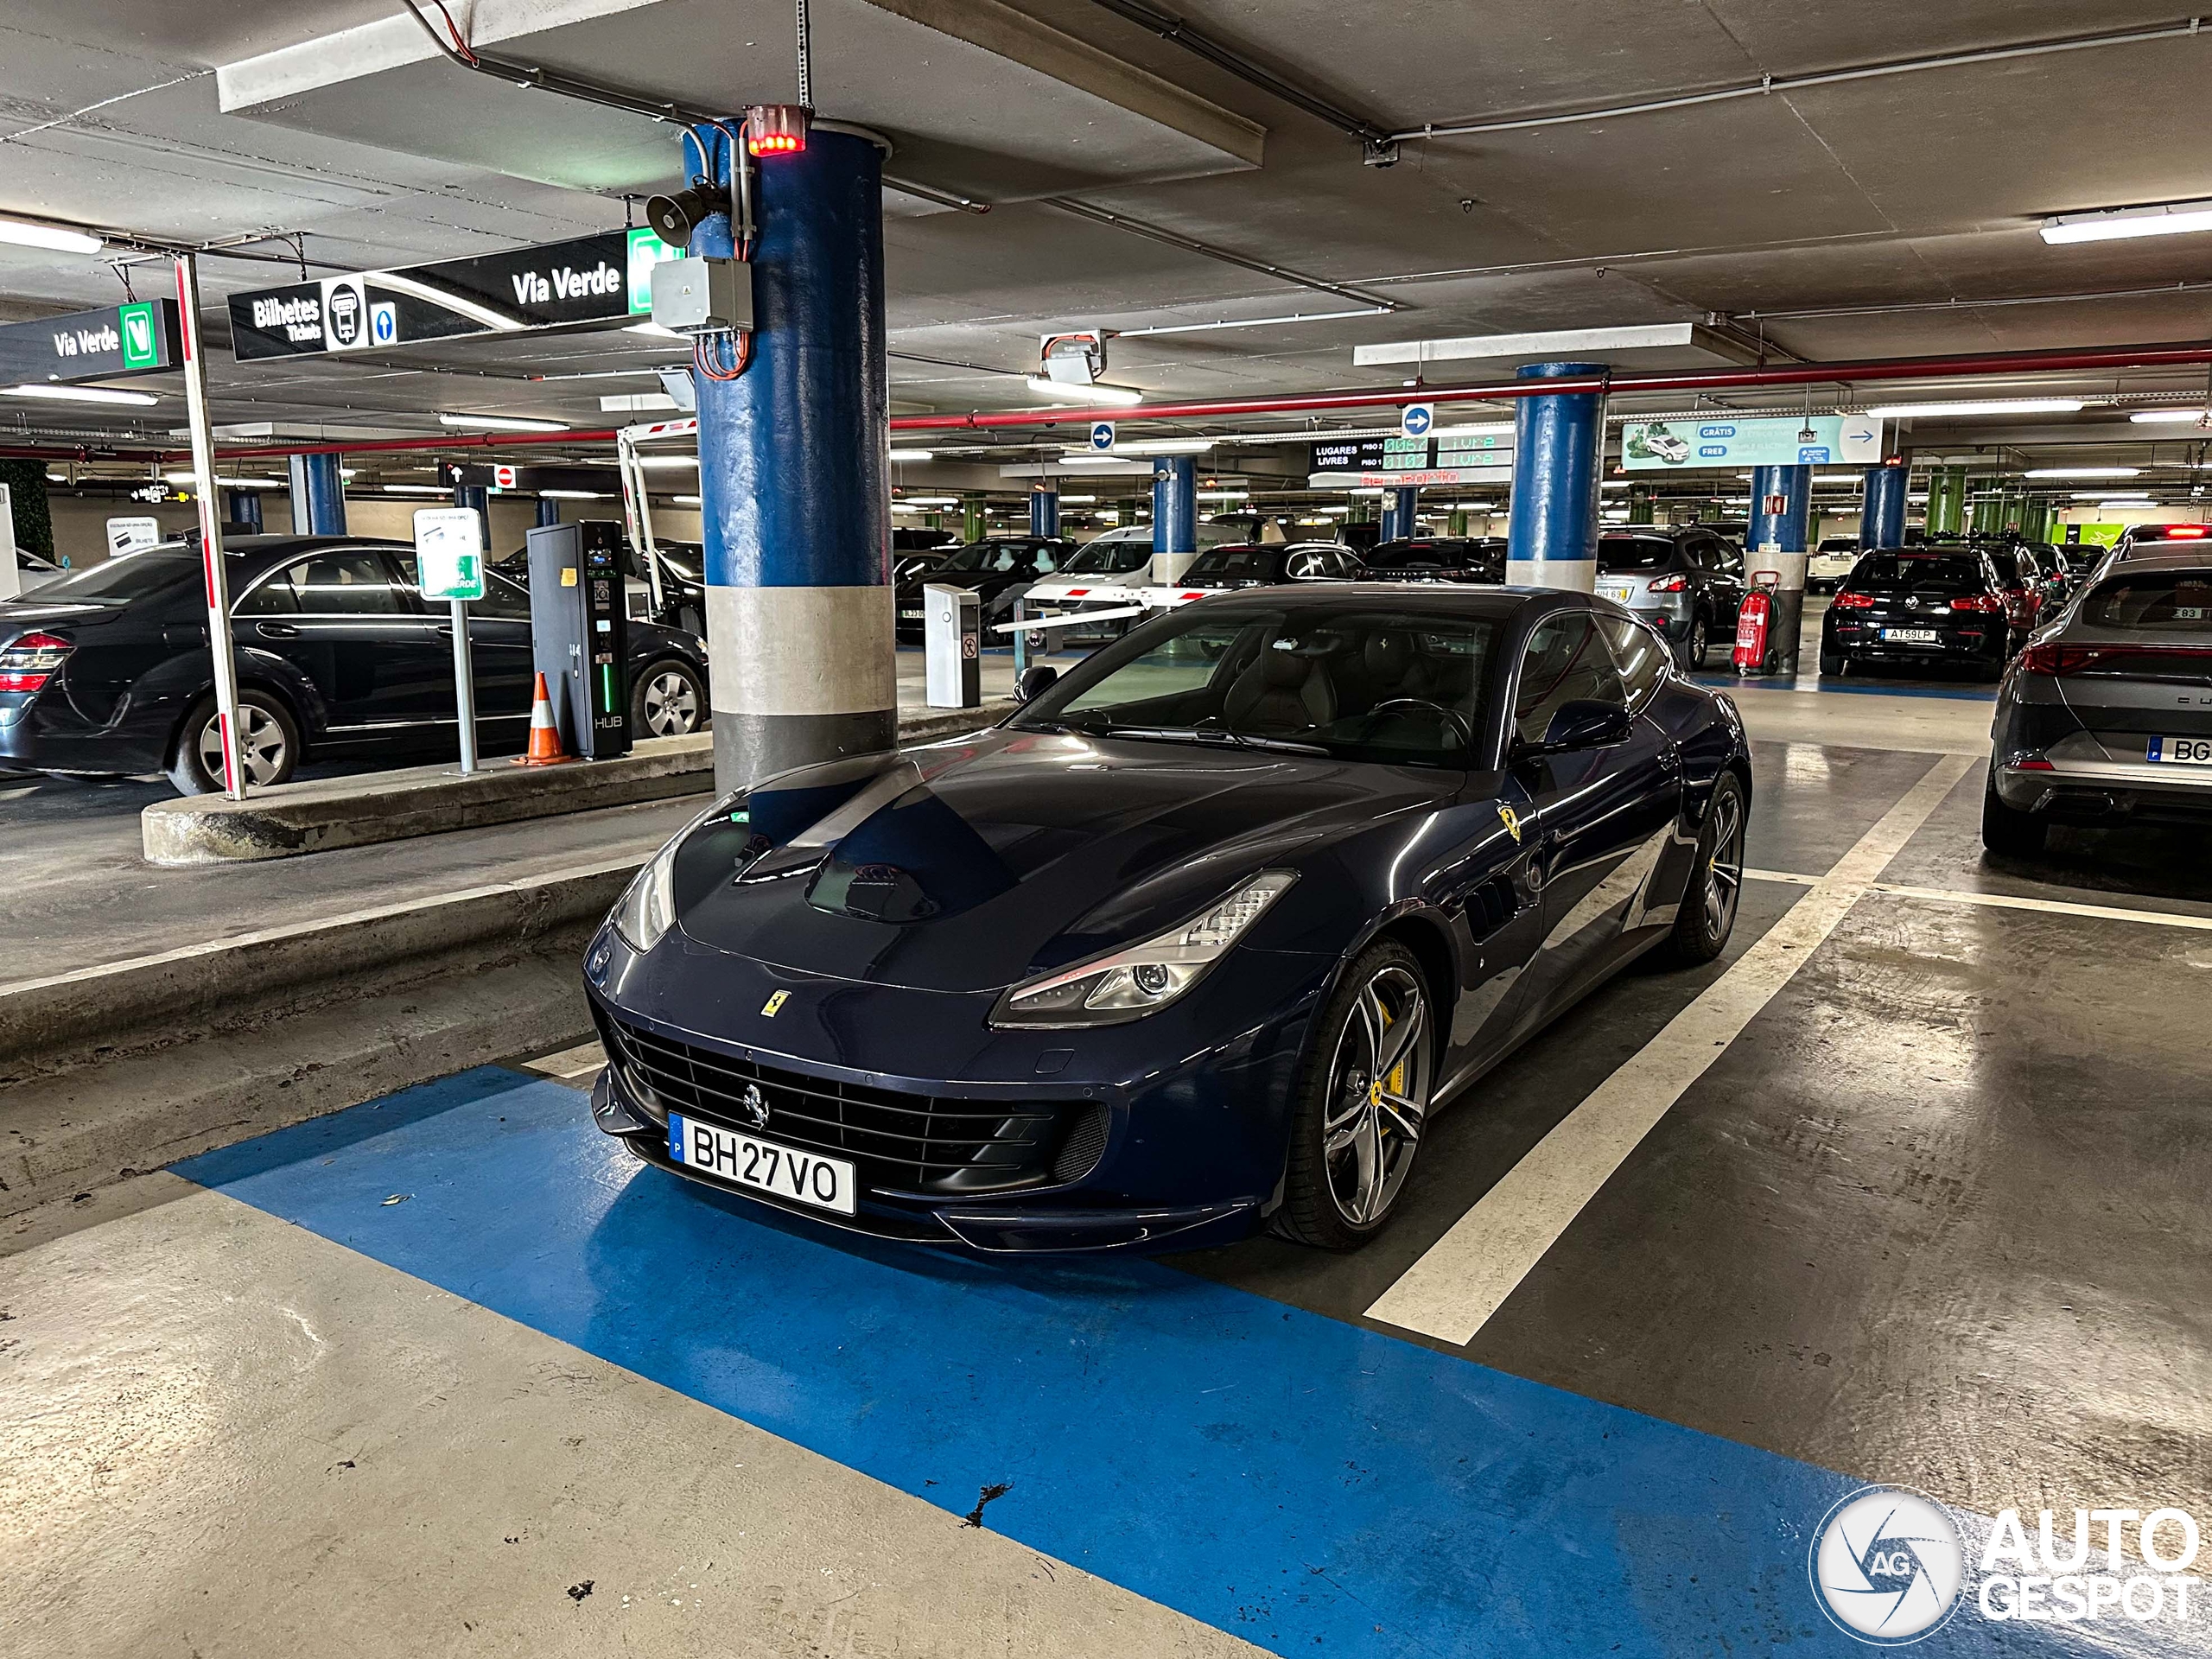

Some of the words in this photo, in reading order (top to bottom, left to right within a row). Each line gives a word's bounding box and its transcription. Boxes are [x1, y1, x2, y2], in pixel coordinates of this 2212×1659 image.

[512, 270, 550, 305] Via
[551, 261, 620, 300] Verde
[252, 297, 320, 328] Bilhetes
[54, 331, 78, 358] Via
[77, 324, 119, 354] Verde
[285, 324, 321, 343] Tickets
[1316, 446, 1357, 455] LUGARES
[1438, 436, 1495, 451] Livre
[1318, 456, 1349, 466] LIVRES
[1437, 452, 1494, 467] Livre
[454, 579, 477, 588] ERDE
[594, 715, 623, 729] HUB
[2174, 740, 2211, 761] BG
[674, 1141, 681, 1153] P
